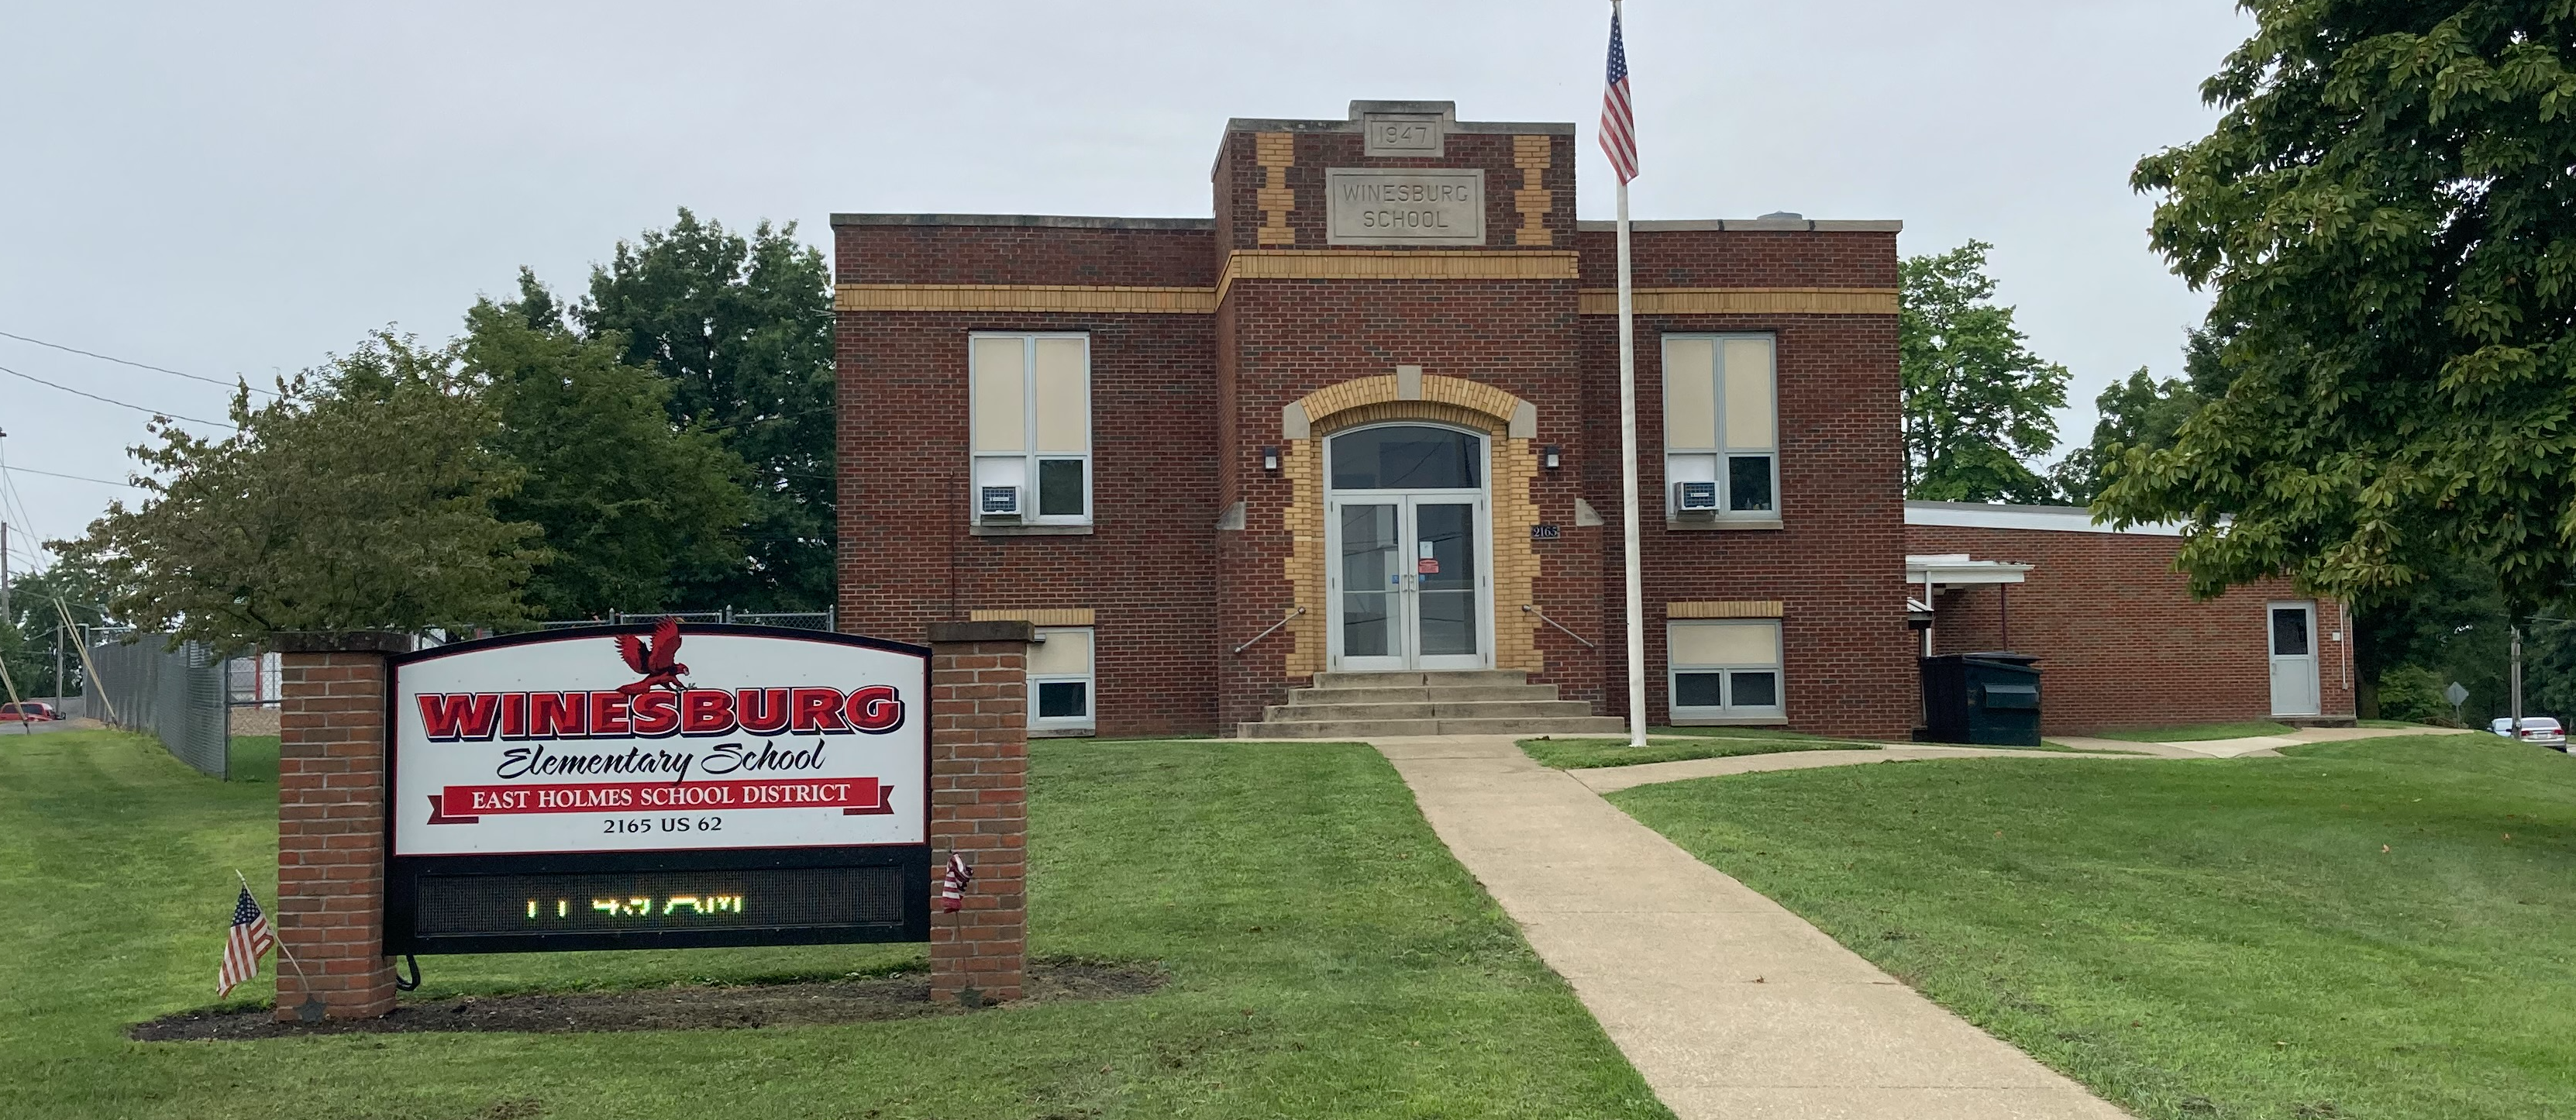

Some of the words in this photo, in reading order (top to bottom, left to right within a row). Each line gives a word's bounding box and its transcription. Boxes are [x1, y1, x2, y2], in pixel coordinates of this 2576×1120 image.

[1379, 126, 1427, 144] 1947
[1343, 184, 1469, 202] WINESBURG
[1363, 211, 1448, 228] SCHOOL
[1534, 527, 1558, 537] 2165
[415, 685, 905, 743] WINESBURG
[496, 744, 694, 786] Elementary
[701, 738, 826, 774] School
[472, 791, 530, 810] EAST
[538, 788, 632, 808] HOLMES
[640, 786, 735, 806] SCHOOL
[742, 783, 851, 804] DISTRICT
[603, 818, 652, 834] 2165
[660, 818, 690, 832] US
[697, 816, 722, 832] 62
